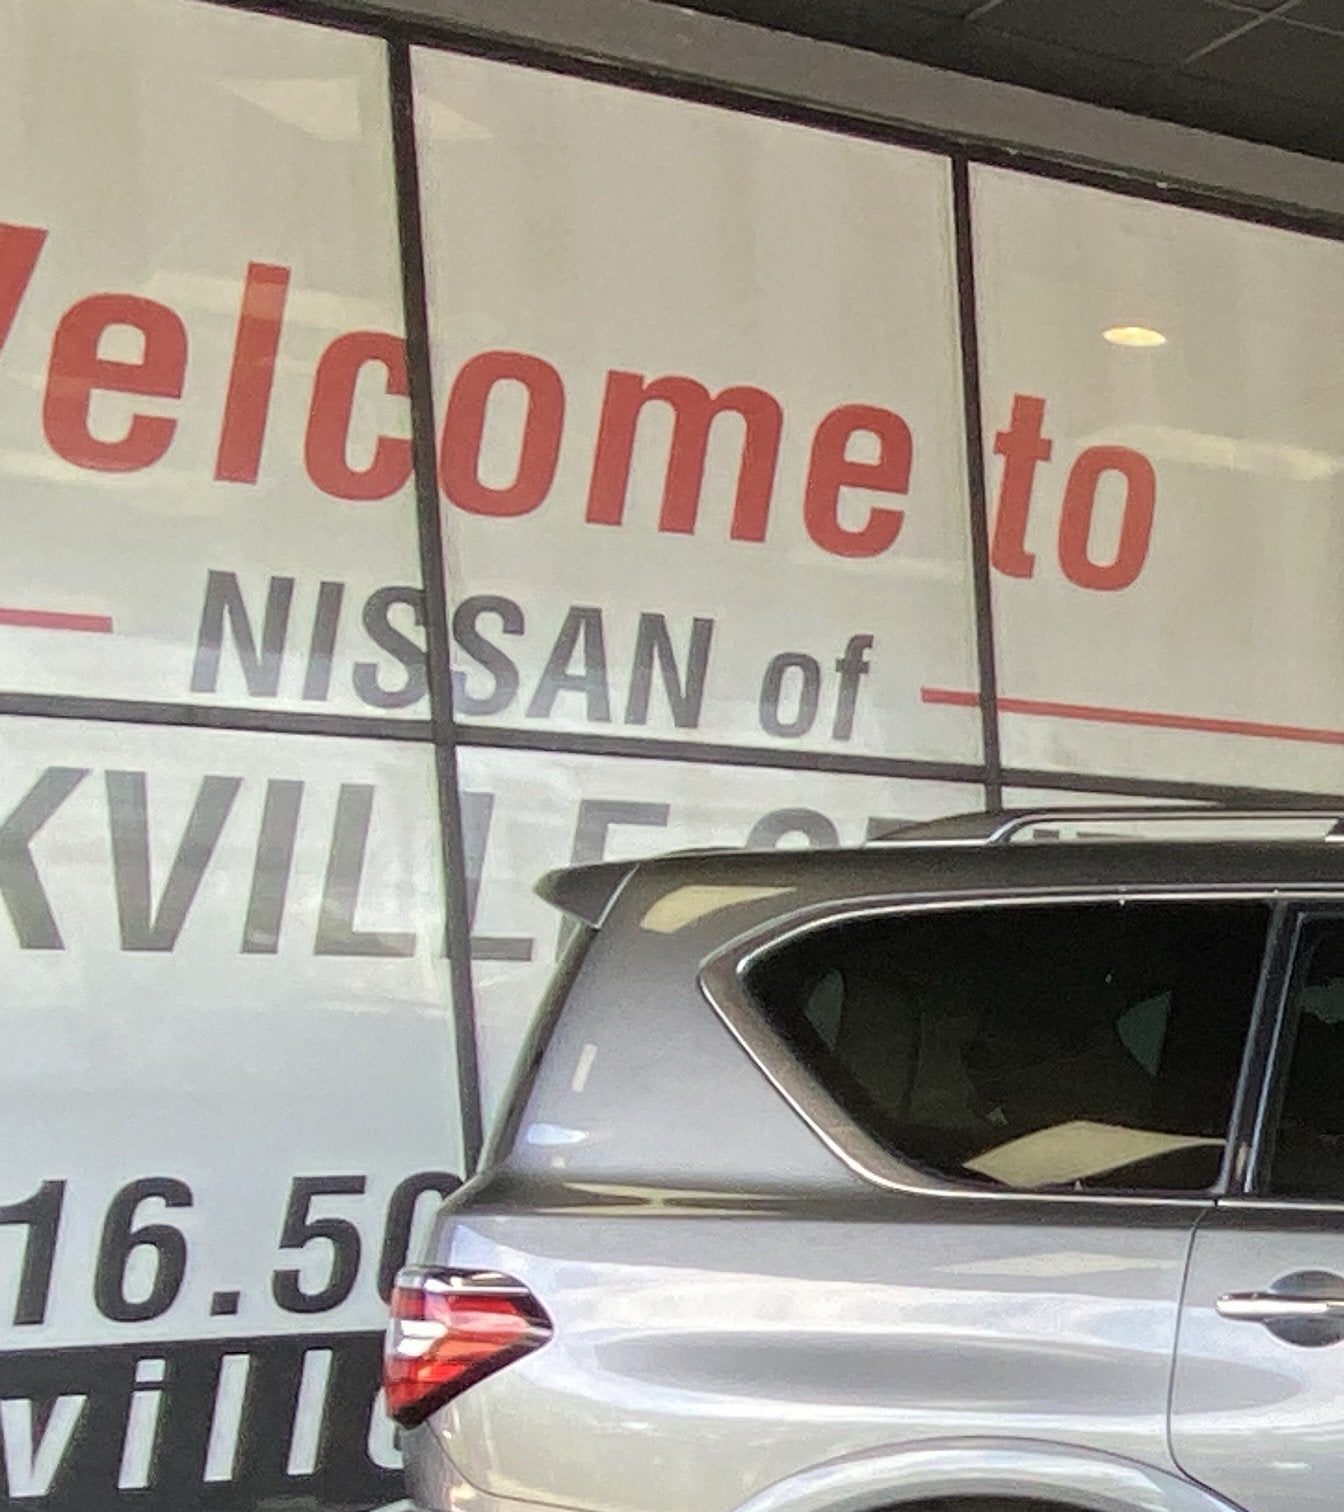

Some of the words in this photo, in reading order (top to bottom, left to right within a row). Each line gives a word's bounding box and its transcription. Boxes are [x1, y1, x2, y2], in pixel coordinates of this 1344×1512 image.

[0, 222, 913, 559] elcome
[989, 393, 1157, 592] to
[190, 569, 715, 729] NISSAN
[759, 634, 874, 742] of
